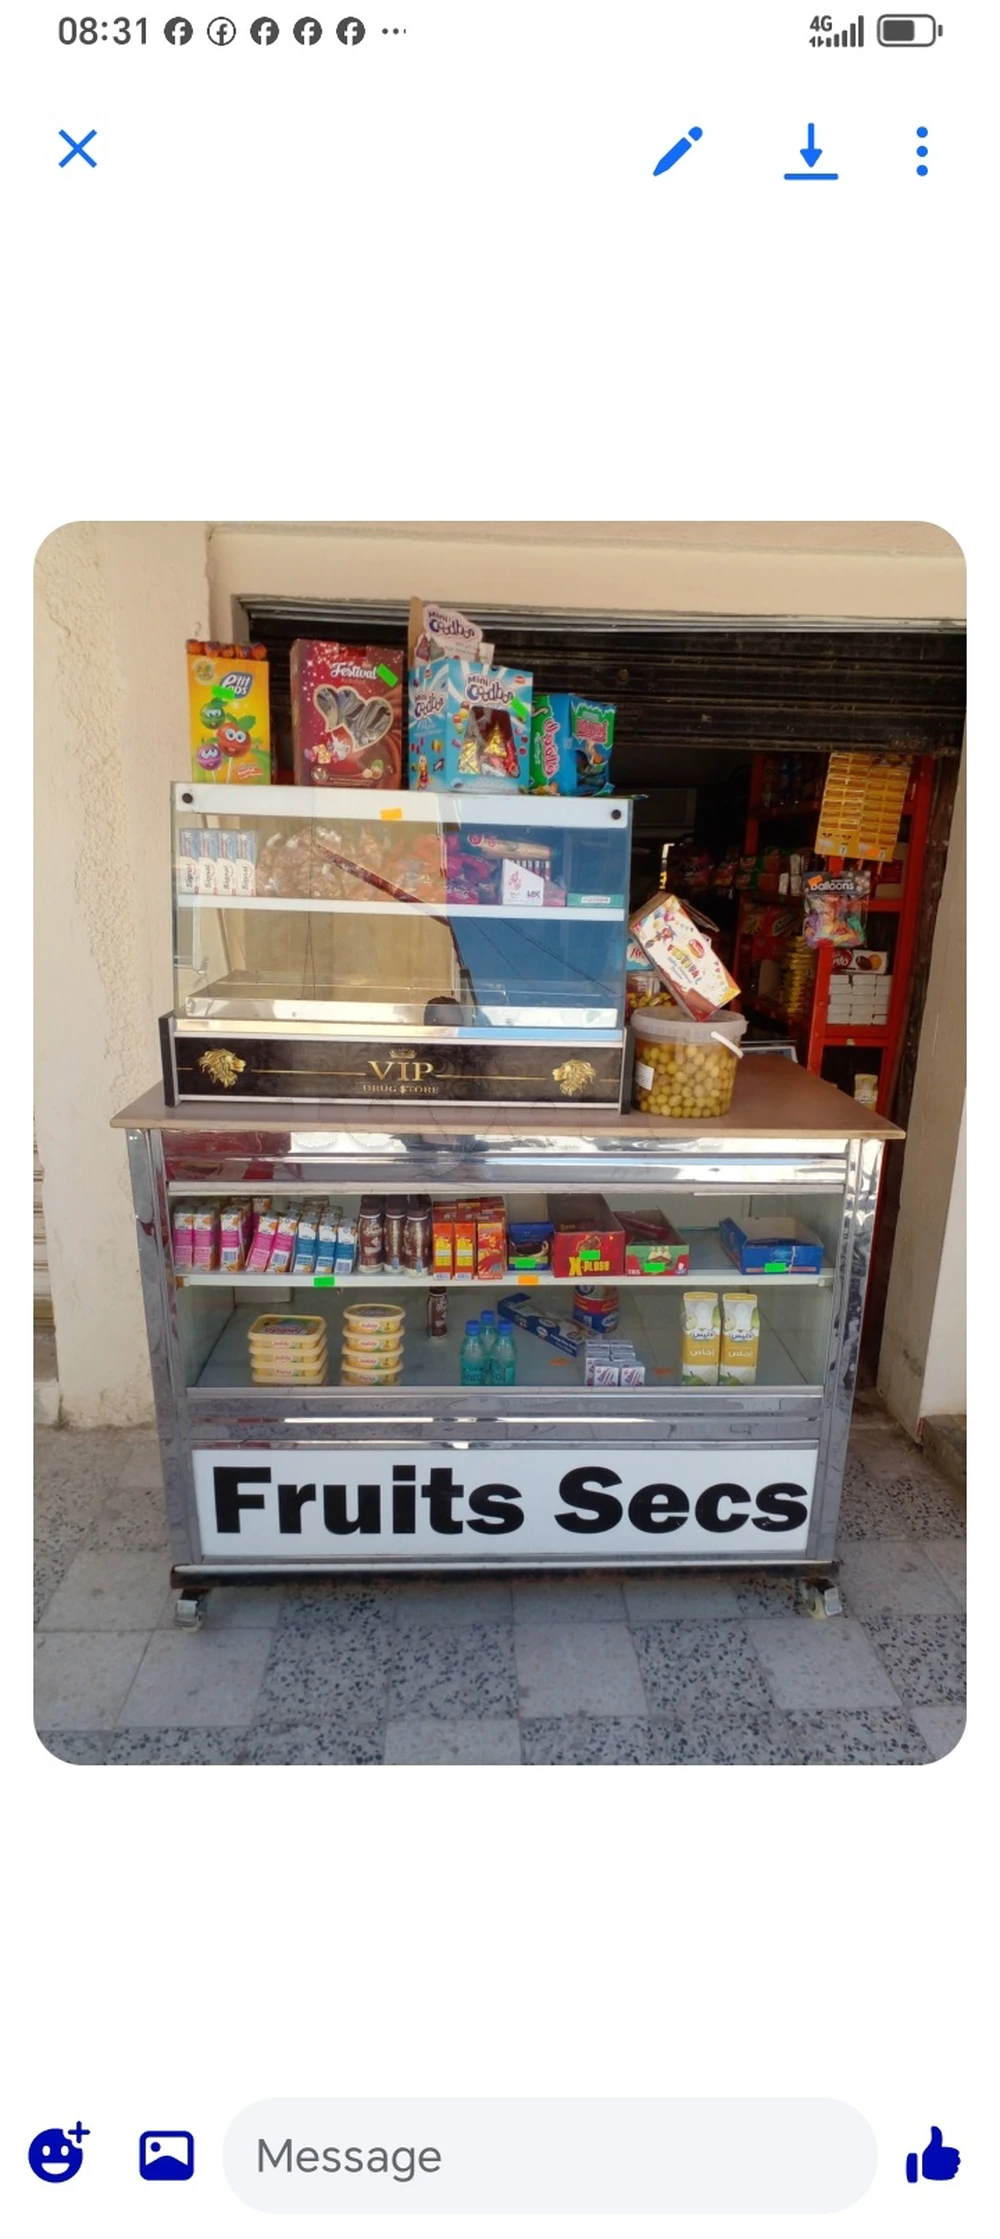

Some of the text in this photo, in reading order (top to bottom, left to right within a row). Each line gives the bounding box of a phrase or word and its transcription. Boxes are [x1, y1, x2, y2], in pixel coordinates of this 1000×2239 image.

[59, 17, 147, 45] 08:31
[809, 16, 833, 31] 4G
[330, 662, 378, 680] Festival
[366, 1061, 433, 1082] VIP
[362, 1084, 397, 1094] DRUG
[213, 1465, 809, 1535] Fruits Secs
[258, 2138, 442, 2183] Message
